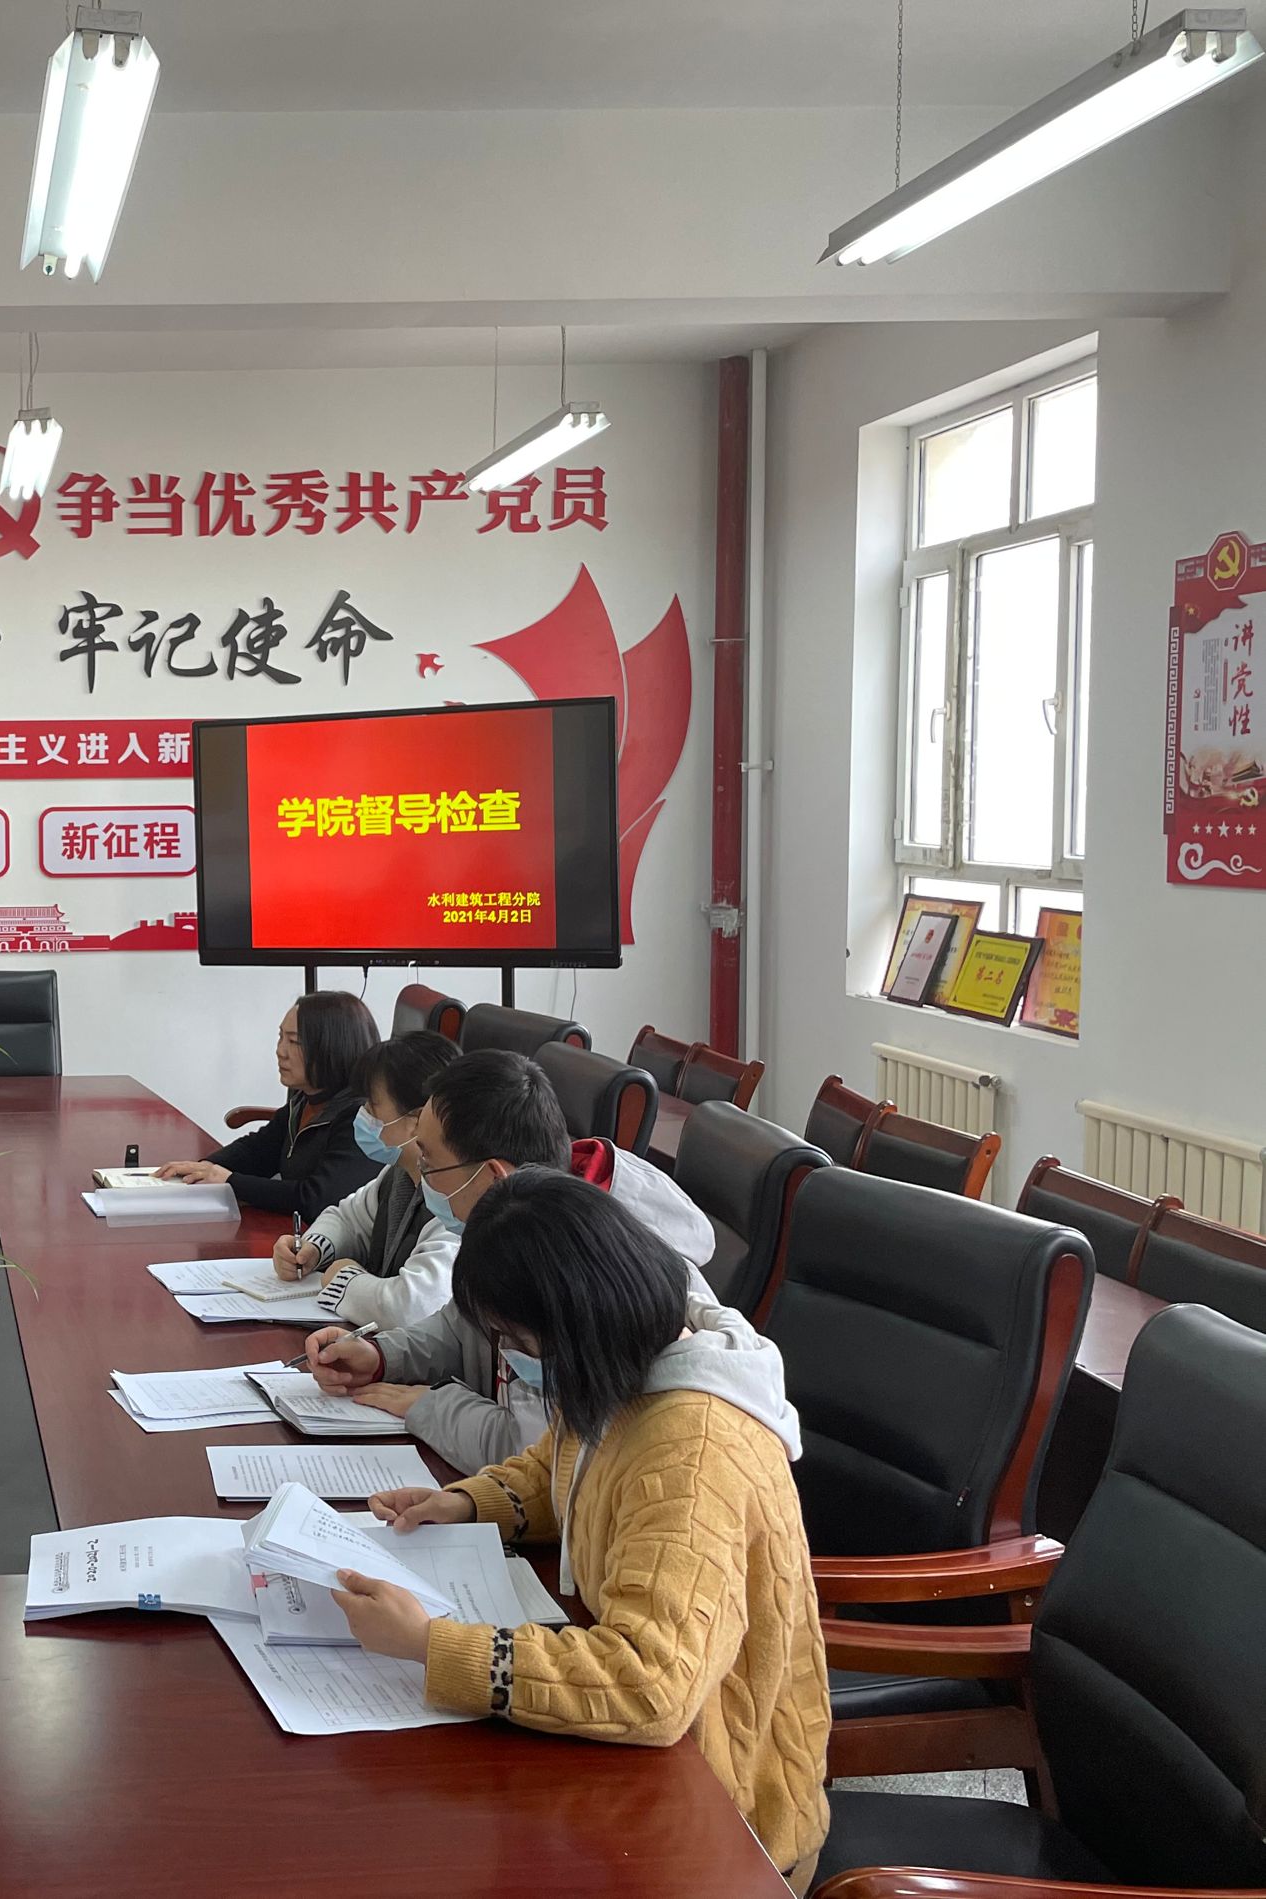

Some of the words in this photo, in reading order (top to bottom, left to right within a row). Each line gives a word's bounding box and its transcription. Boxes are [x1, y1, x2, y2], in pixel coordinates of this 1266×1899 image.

[56, 467, 608, 538] 争当优秀共产党员
[57, 590, 394, 694] 牢记使命
[1229, 619, 1255, 736] 讲党性
[277, 789, 521, 838] 学院督导检查
[61, 821, 181, 861] 新征程
[427, 892, 541, 907] 水利建筑工程分院
[443, 909, 532, 924] 2021年4月2日
